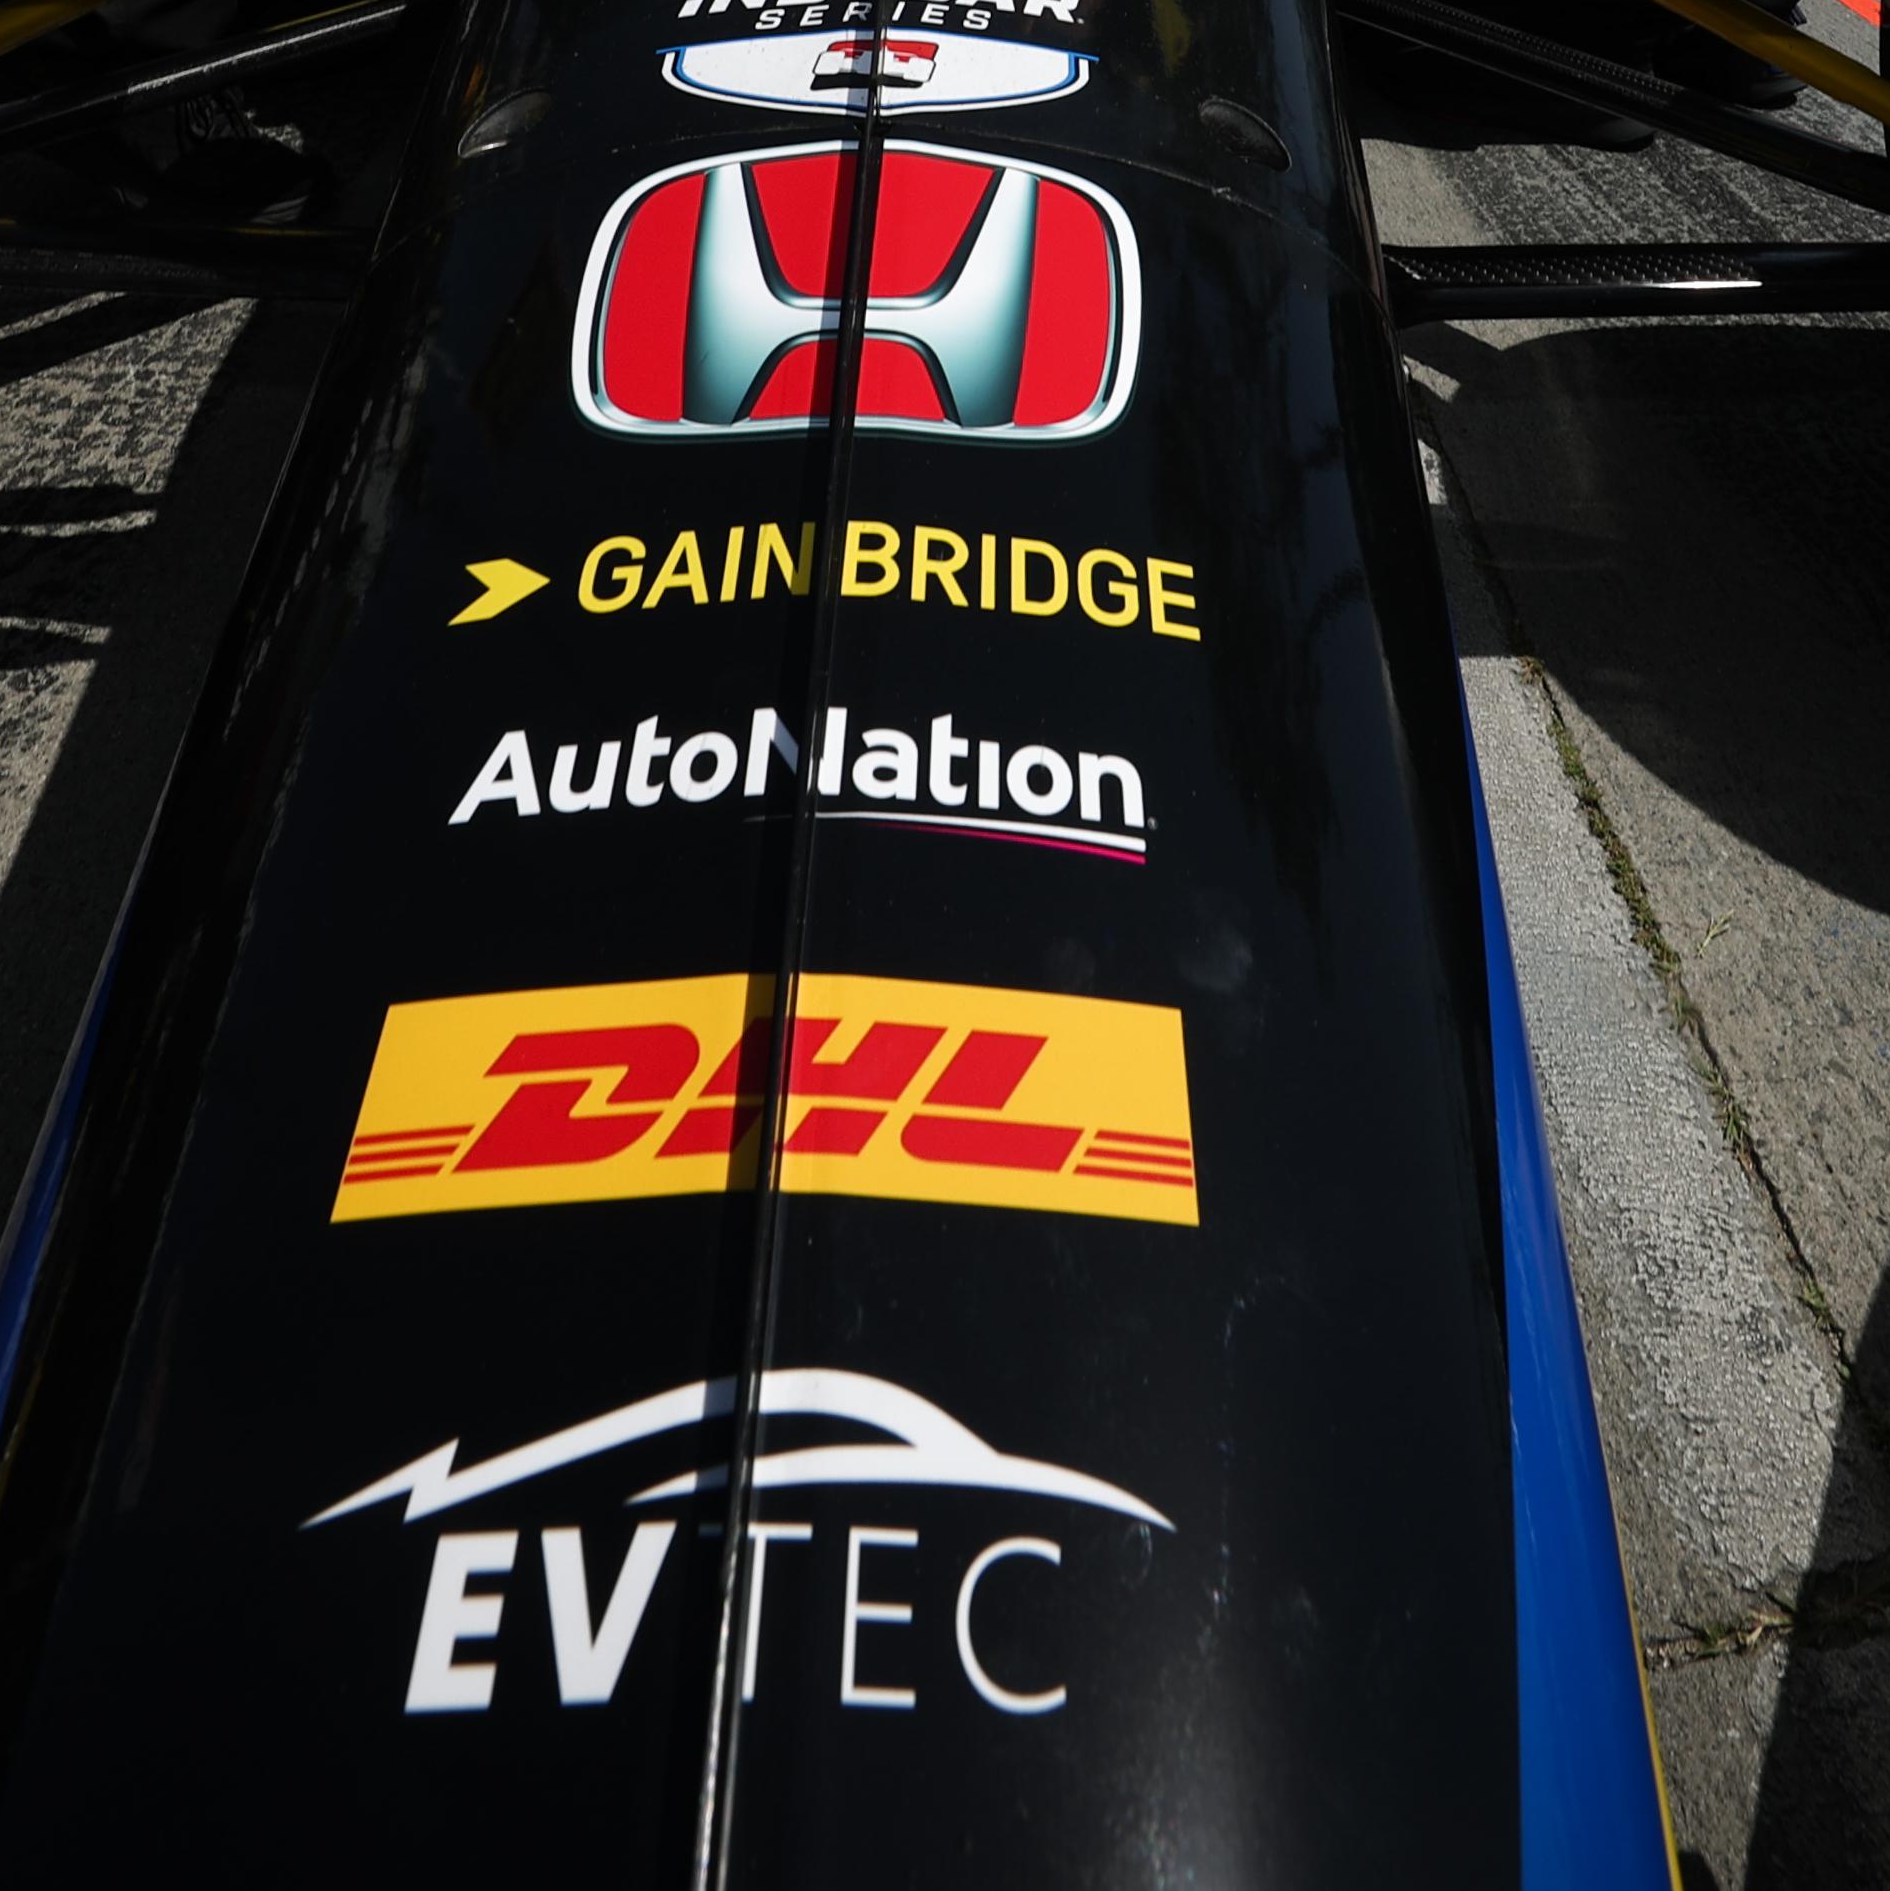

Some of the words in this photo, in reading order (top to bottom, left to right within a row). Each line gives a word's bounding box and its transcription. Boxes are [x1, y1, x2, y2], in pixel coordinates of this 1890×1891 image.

[754, 3, 992, 32] SERIES
[578, 520, 1202, 642] GAINBRIDGE
[447, 706, 1146, 828] AutoNation
[451, 1017, 1085, 1174] DHL
